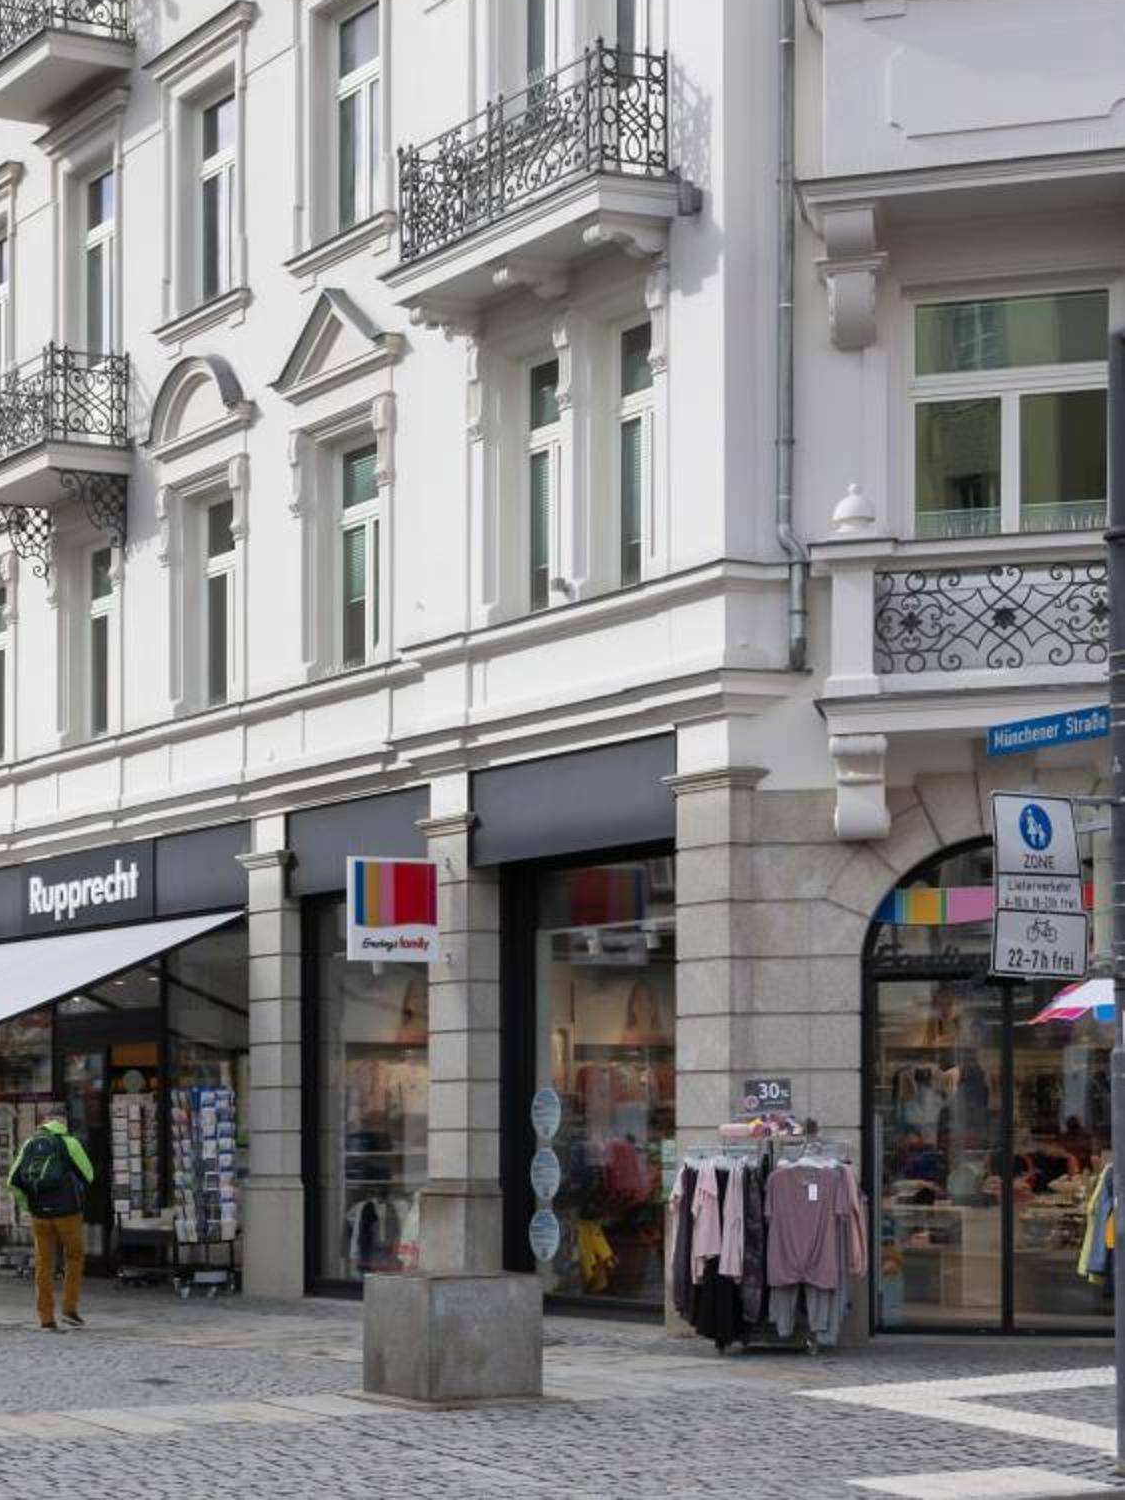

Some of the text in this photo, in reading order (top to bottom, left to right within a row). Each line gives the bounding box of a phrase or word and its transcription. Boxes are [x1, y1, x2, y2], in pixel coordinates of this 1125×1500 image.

[1023, 853, 1054, 869] ZONE
[29, 859, 139, 921] Rupprecht
[1052, 951, 1075, 972] frei
